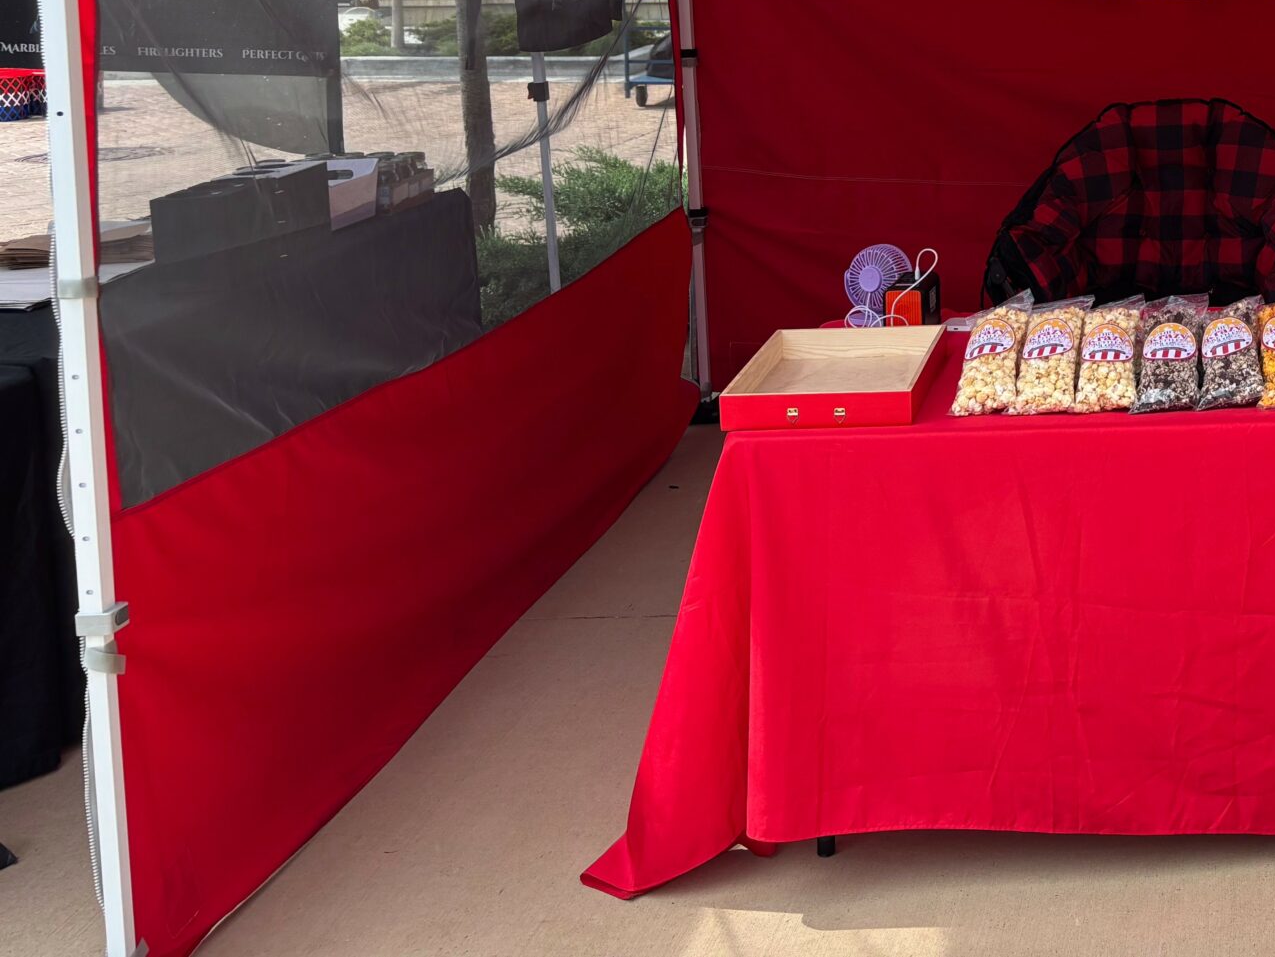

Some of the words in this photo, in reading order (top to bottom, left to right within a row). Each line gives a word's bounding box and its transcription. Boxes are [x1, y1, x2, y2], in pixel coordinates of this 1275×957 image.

[0, 41, 42, 54] MARBL
[137, 46, 224, 59] FIRLIGHTERS
[242, 49, 294, 60] PERFECT
